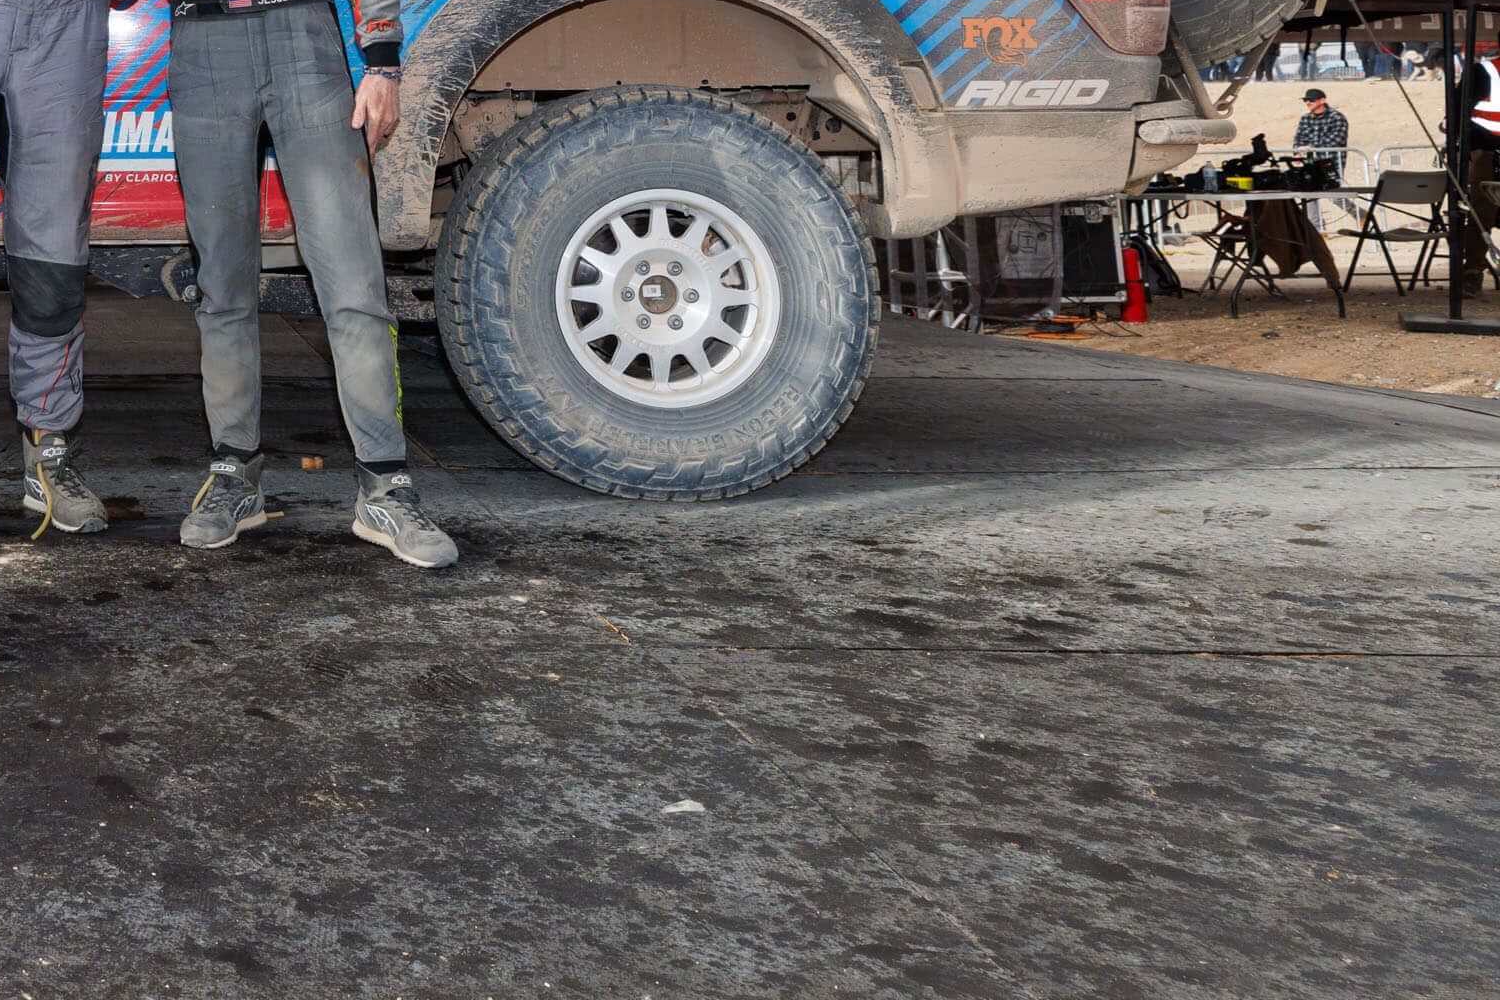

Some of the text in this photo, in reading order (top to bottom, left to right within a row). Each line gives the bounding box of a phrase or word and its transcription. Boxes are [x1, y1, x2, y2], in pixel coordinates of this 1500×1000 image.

[961, 16, 1039, 67] FOX
[955, 78, 1110, 108] RIGID
[105, 173, 122, 183] BY
